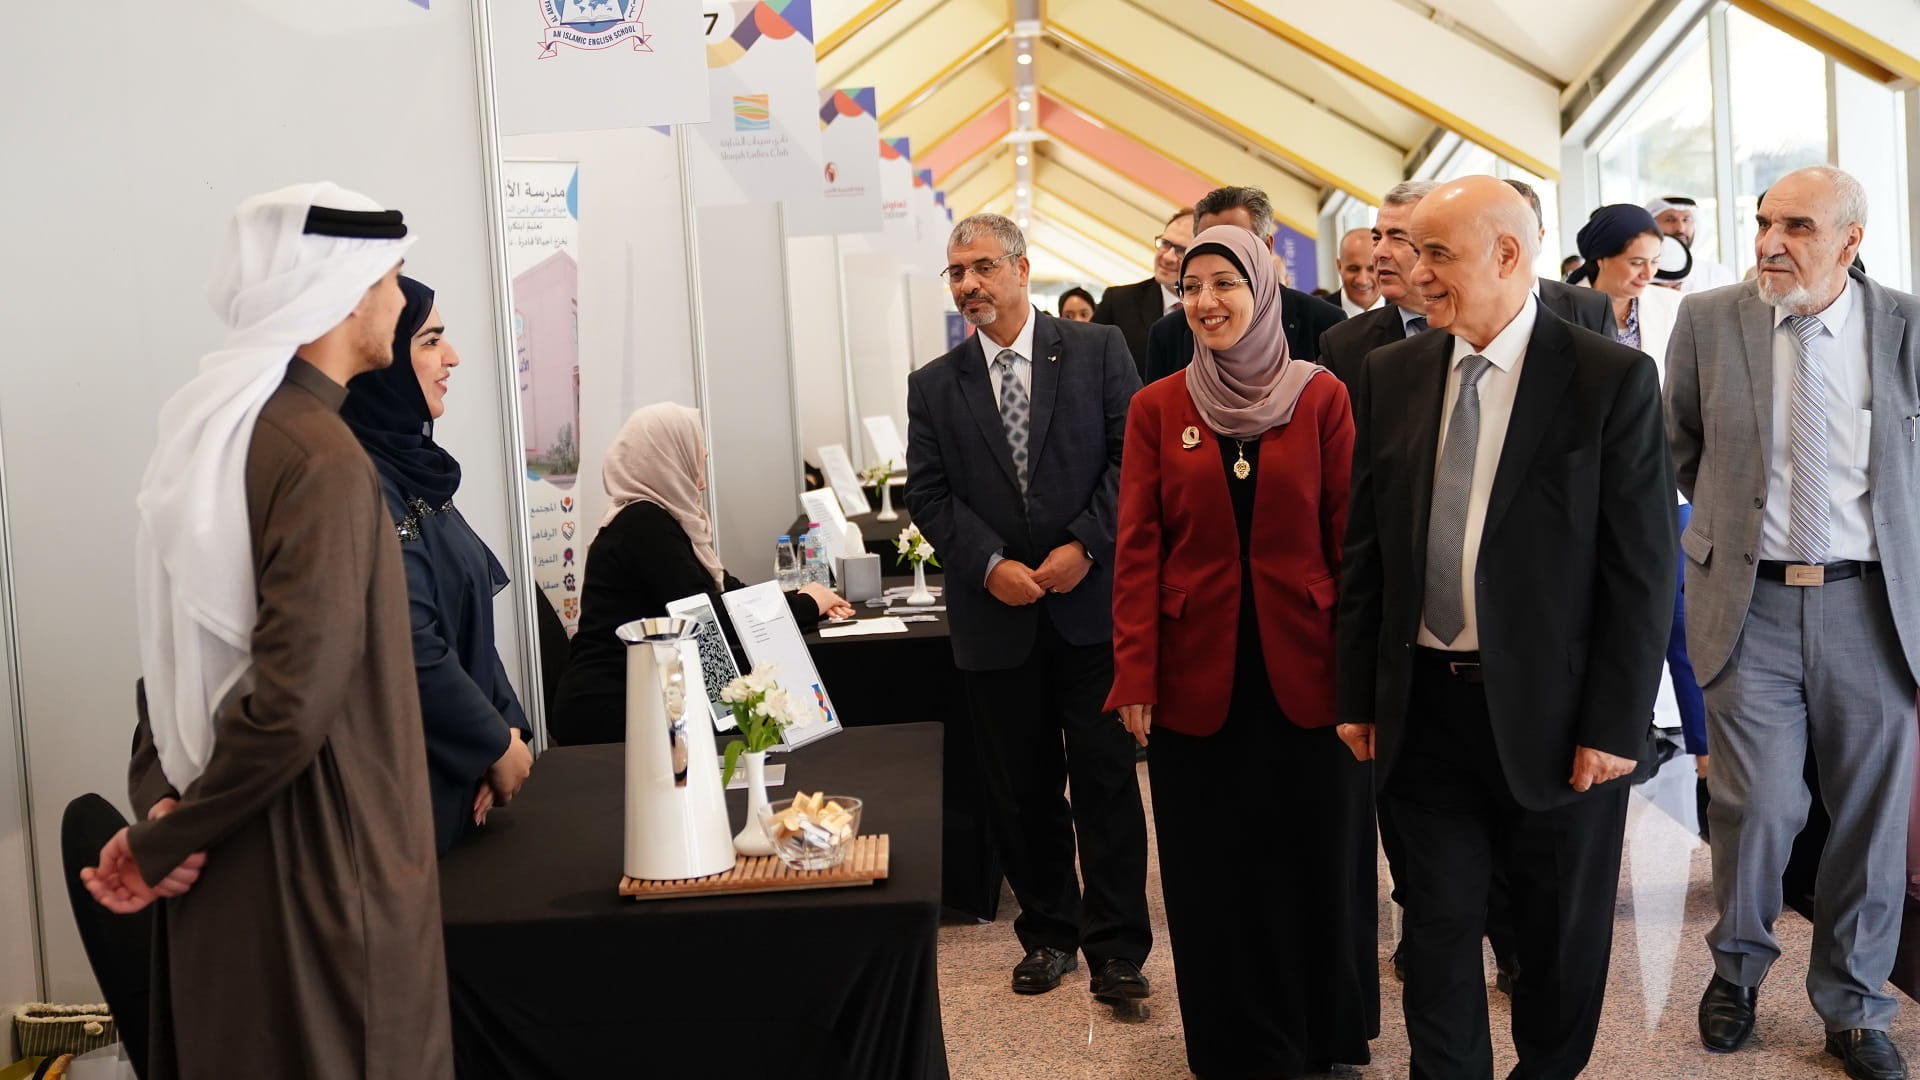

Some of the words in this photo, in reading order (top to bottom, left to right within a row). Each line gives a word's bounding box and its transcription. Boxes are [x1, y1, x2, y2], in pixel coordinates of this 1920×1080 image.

[553, 30, 561, 38] AN
[563, 32, 587, 45] ISLAMIC
[588, 36, 614, 46] ENGLISH
[613, 25, 636, 39] SCHOOL
[770, 147, 789, 158] Club
[525, 182, 565, 203] مدرسة
[1284, 237, 1296, 267] Fair
[531, 503, 557, 518] المجتمع
